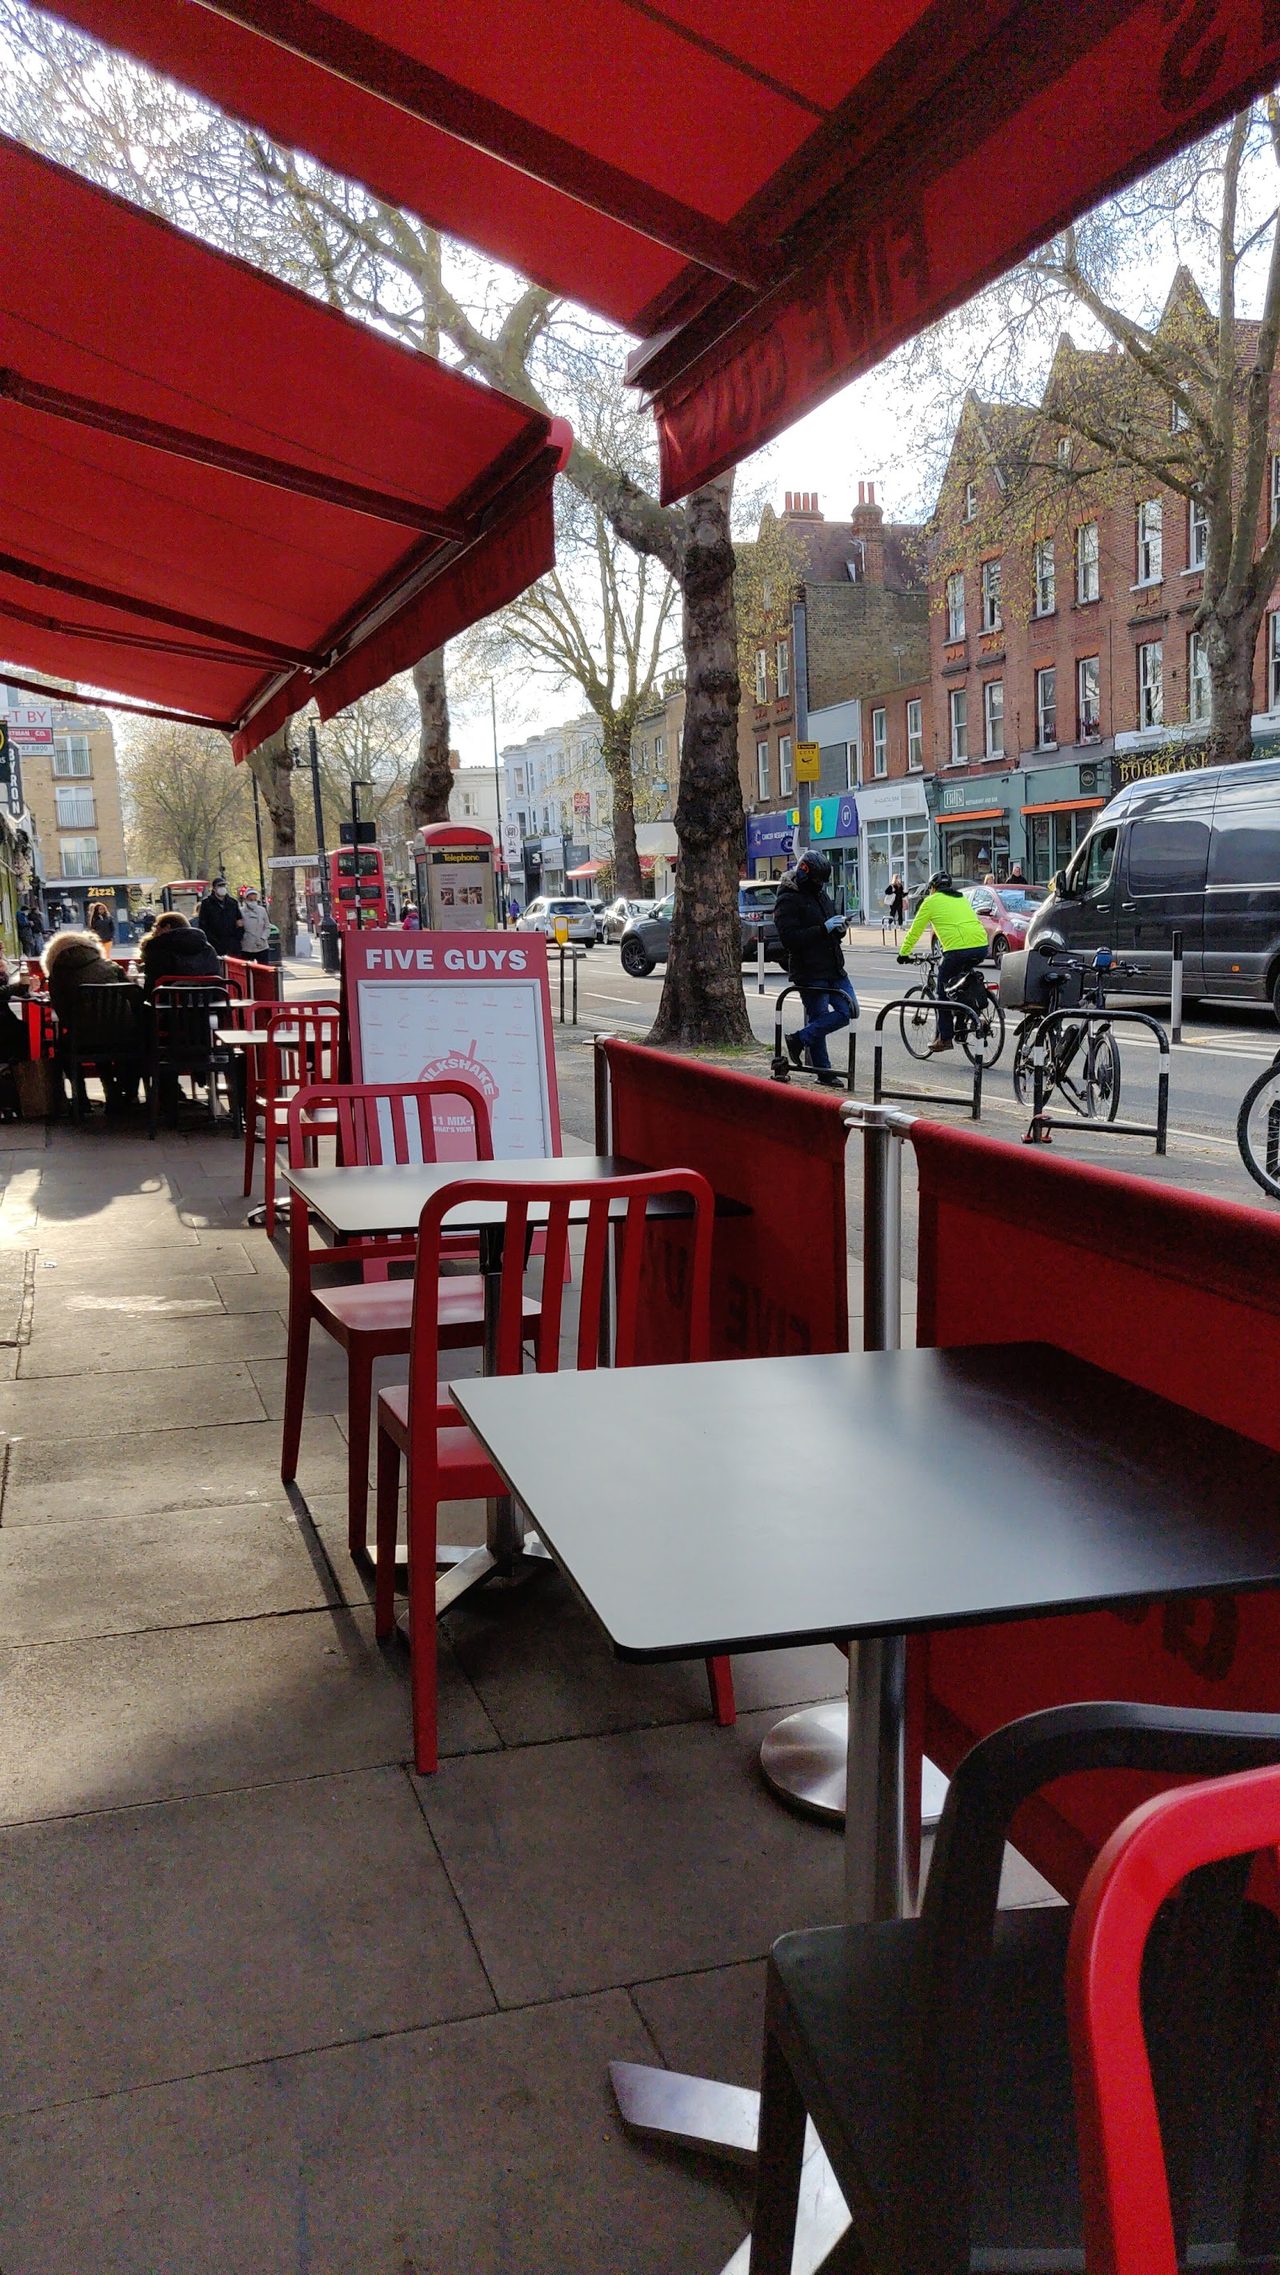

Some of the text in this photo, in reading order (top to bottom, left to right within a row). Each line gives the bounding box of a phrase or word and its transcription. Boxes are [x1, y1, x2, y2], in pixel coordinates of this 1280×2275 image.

[27, 711, 46, 723] BY
[8, 748, 21, 814] BYRON
[443, 853, 480, 863] Telephone
[87, 886, 116, 898] Zizzi
[366, 948, 526, 971] FIVE GUYS
